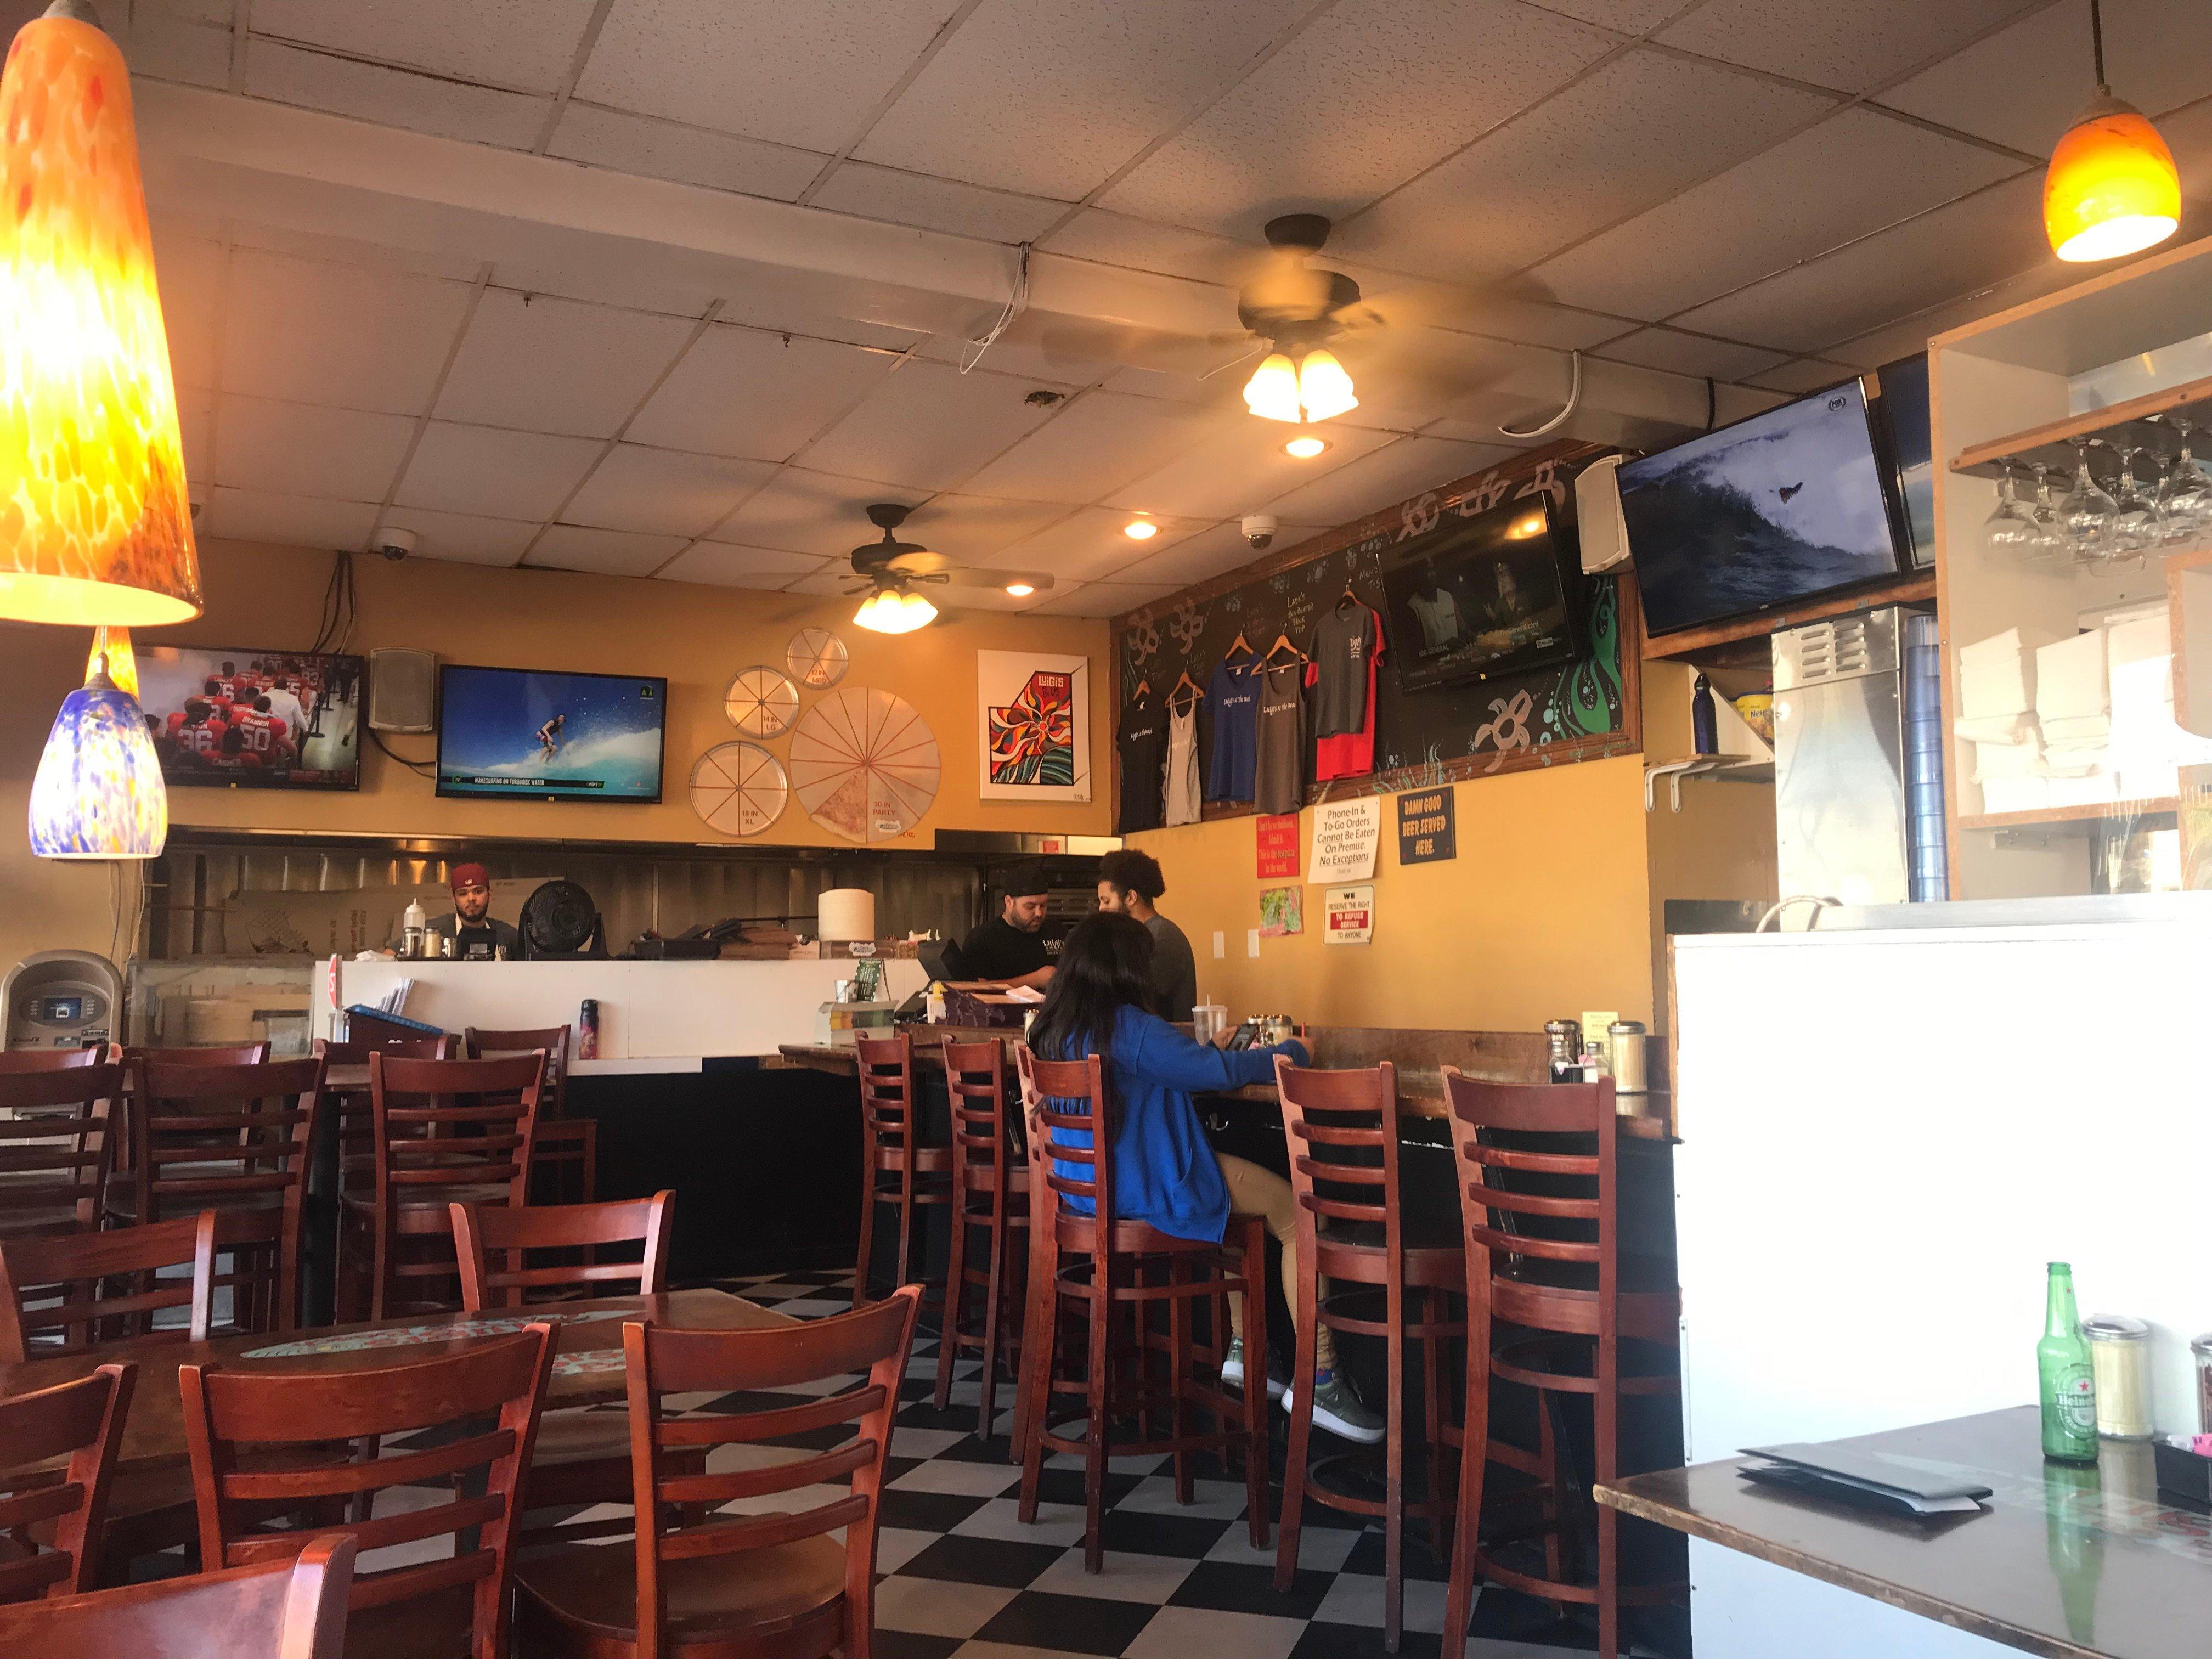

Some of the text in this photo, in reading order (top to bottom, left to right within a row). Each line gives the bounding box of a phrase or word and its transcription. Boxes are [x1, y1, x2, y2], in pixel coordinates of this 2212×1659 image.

[1328, 805, 1365, 819] Phone-In &
[1405, 794, 1442, 816] DAMN GOOD
[1324, 818, 1370, 831] To-Go Orders
[1402, 815, 1446, 837] BEER SERVED
[1317, 828, 1375, 843] Cannot Be Eaten
[1325, 841, 1365, 854] On Premise.
[1415, 838, 1435, 856] HERE.
[1319, 852, 1369, 866] No Exceptions
[1345, 912, 1364, 920] REFUSE
